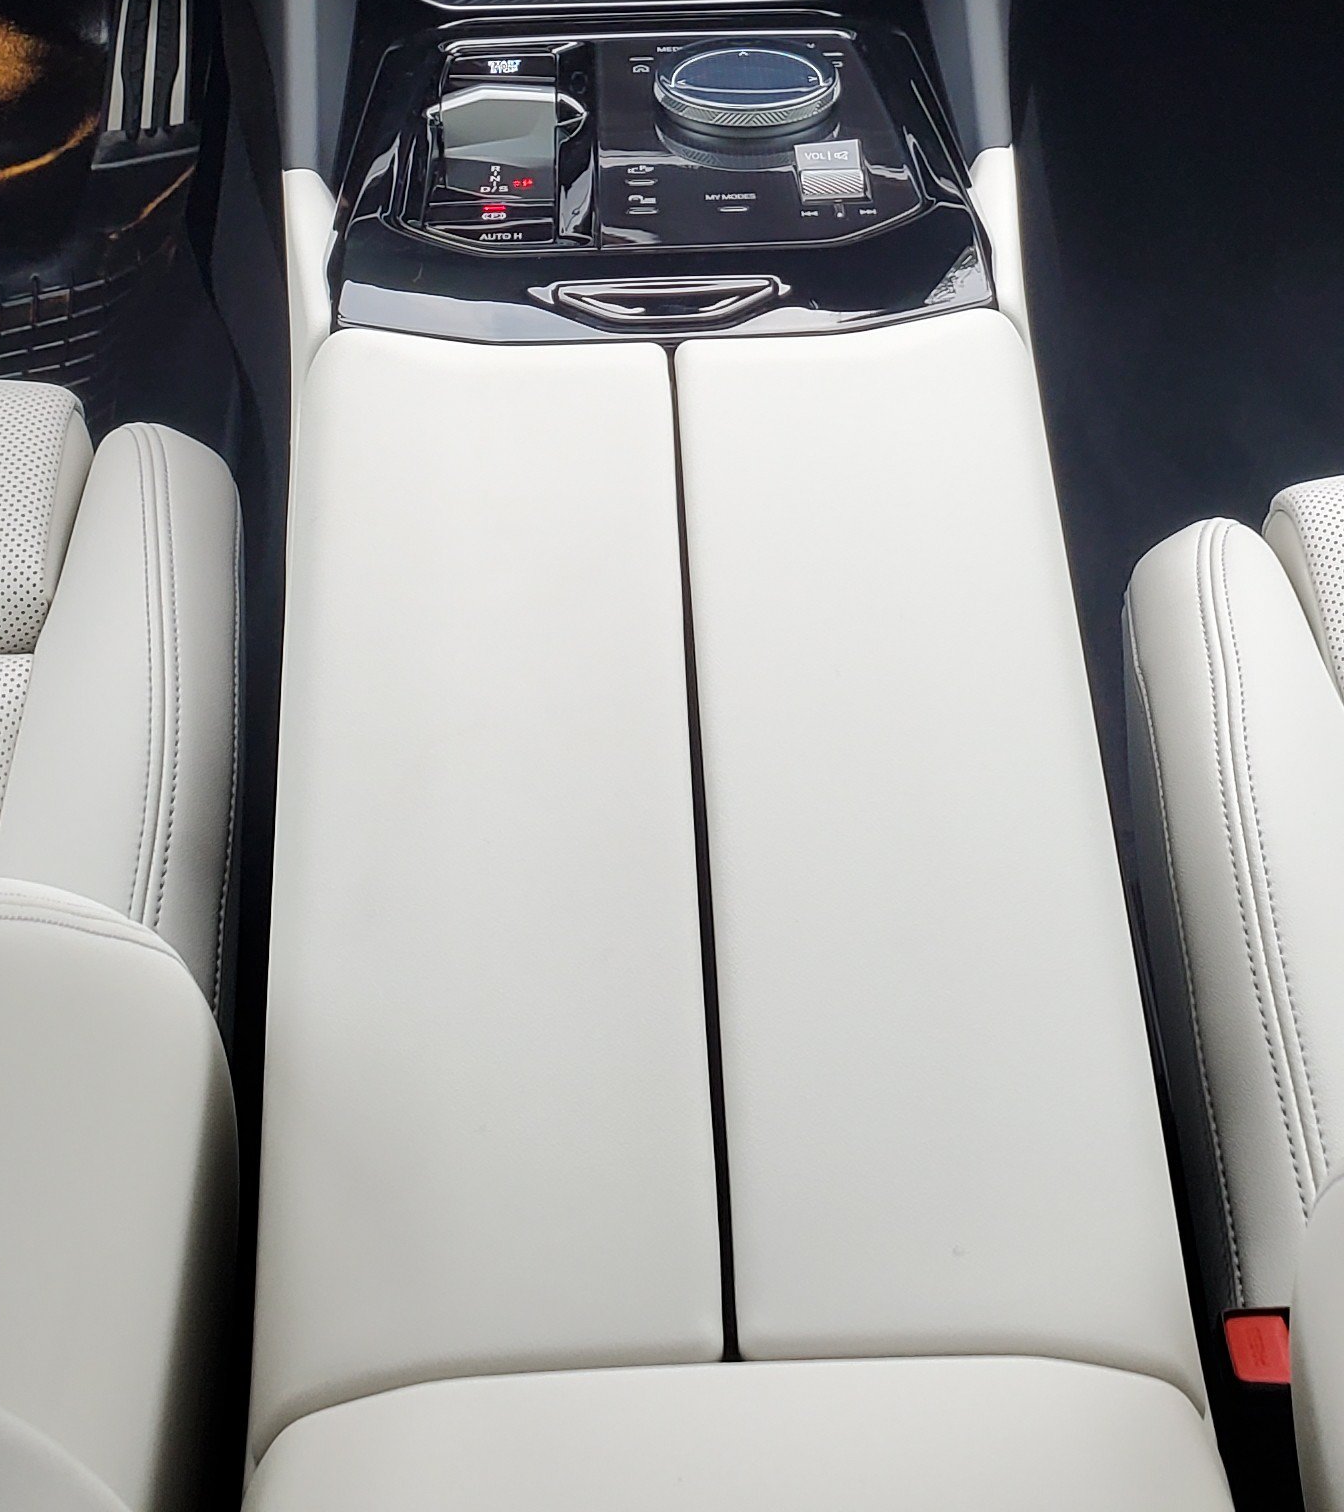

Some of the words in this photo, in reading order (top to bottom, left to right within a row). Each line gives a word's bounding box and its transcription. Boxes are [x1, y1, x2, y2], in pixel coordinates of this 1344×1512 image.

[805, 151, 826, 161] VOL
[705, 193, 720, 201] MY
[721, 192, 756, 201] MODES
[479, 232, 511, 240] AUTO
[514, 232, 523, 240] H
